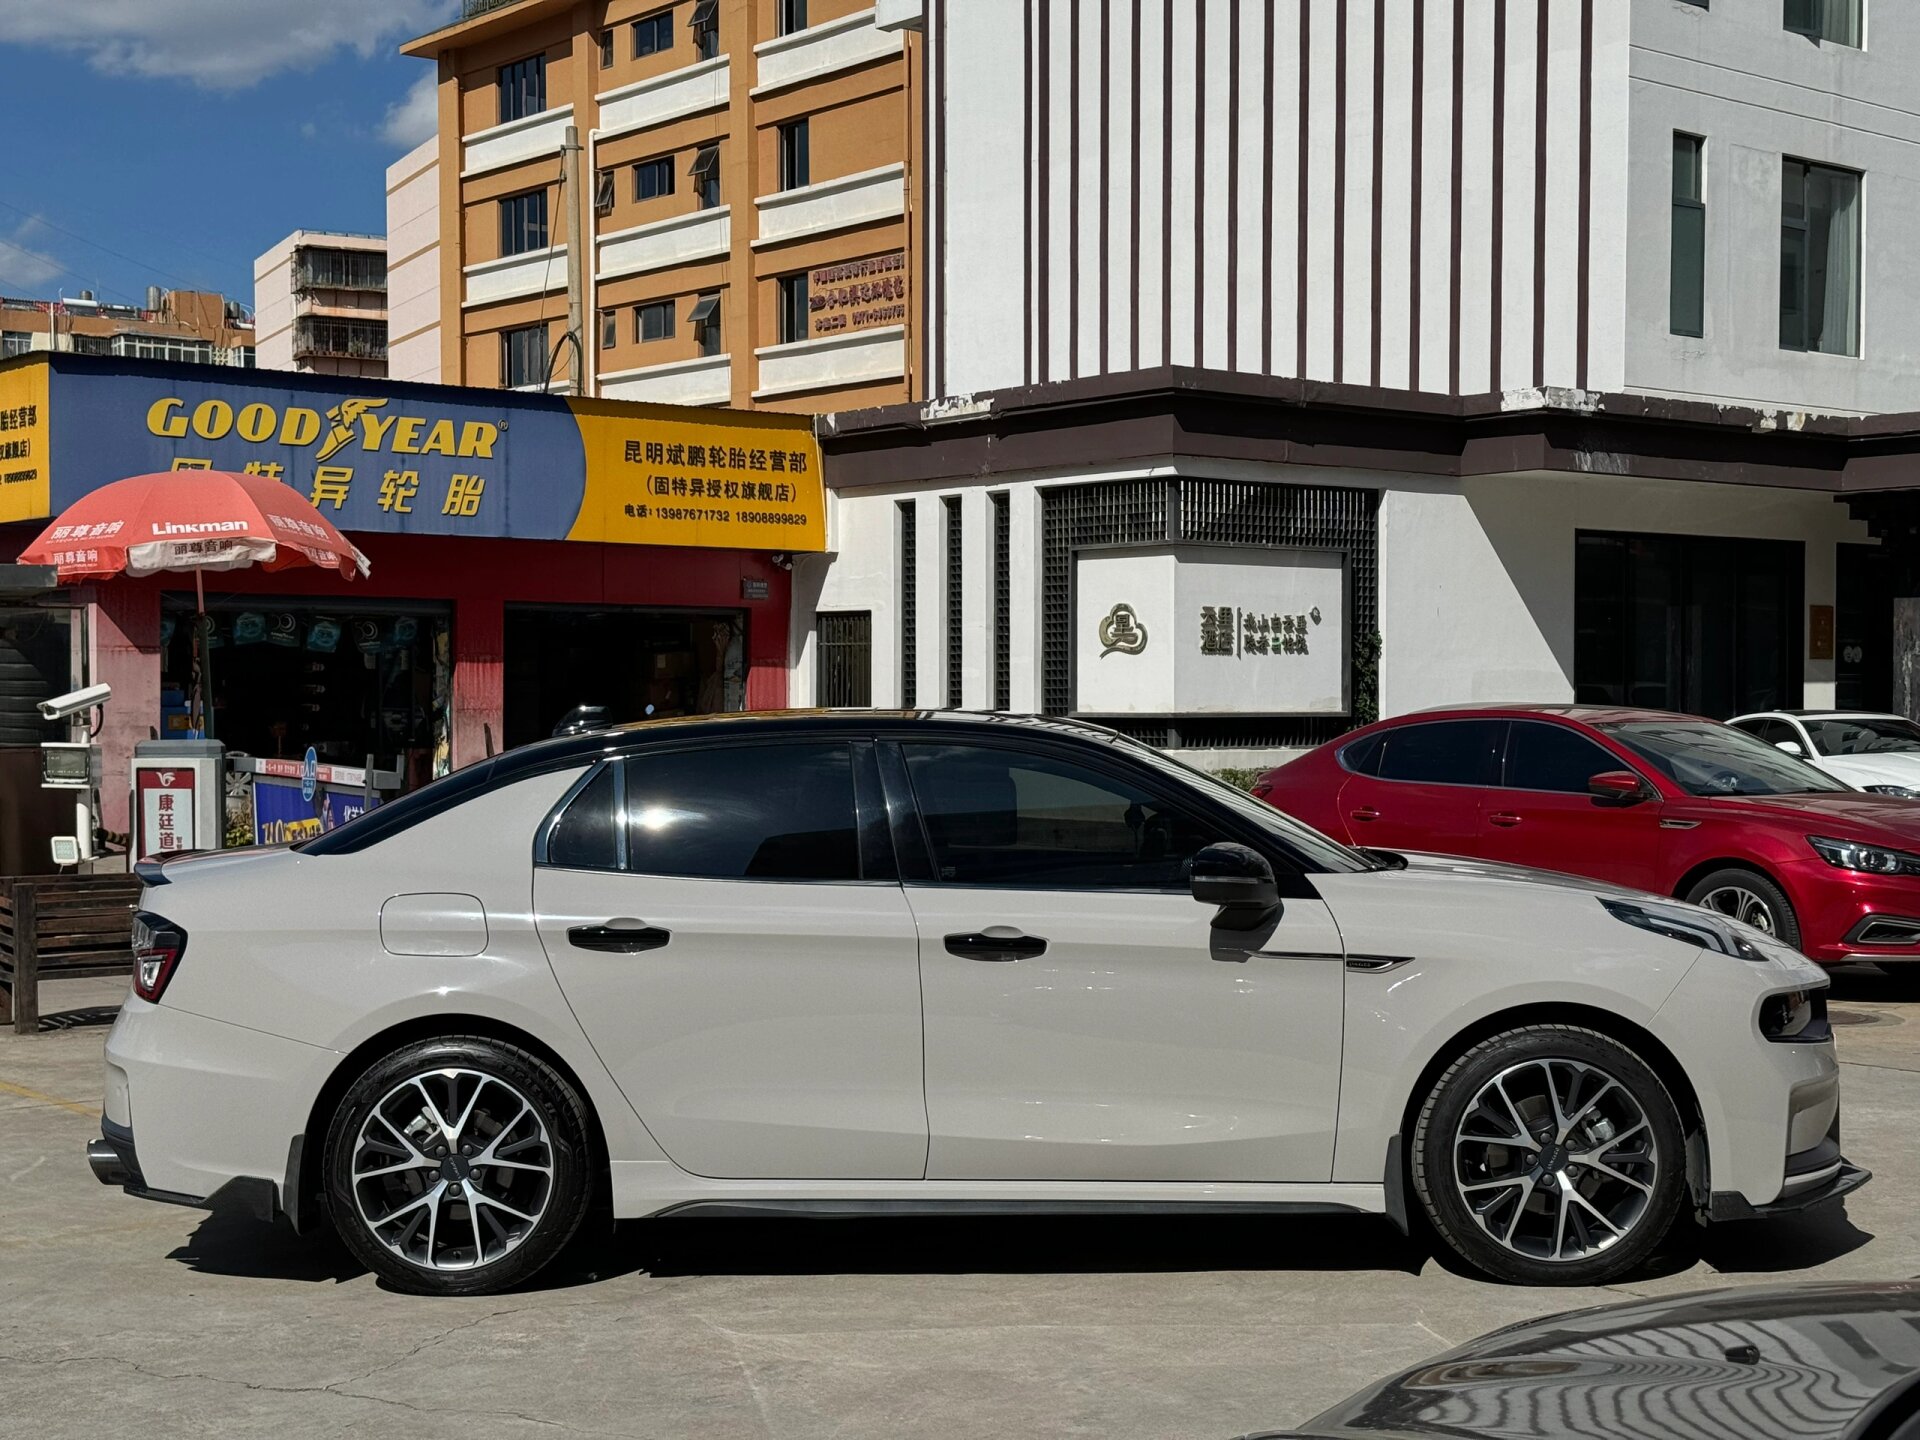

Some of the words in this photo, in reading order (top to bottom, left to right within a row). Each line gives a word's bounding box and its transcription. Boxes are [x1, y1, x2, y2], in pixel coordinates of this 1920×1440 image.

[624, 440, 808, 474] 昆明斌鹏轮胎经营部
[736, 510, 807, 526] 18908899829
[50, 519, 125, 540] 丽尊音响
[152, 519, 249, 536] Linkman
[174, 539, 234, 556] 丽尊音响
[53, 549, 98, 565] 丽尊音响
[158, 793, 174, 850] 康廷道
